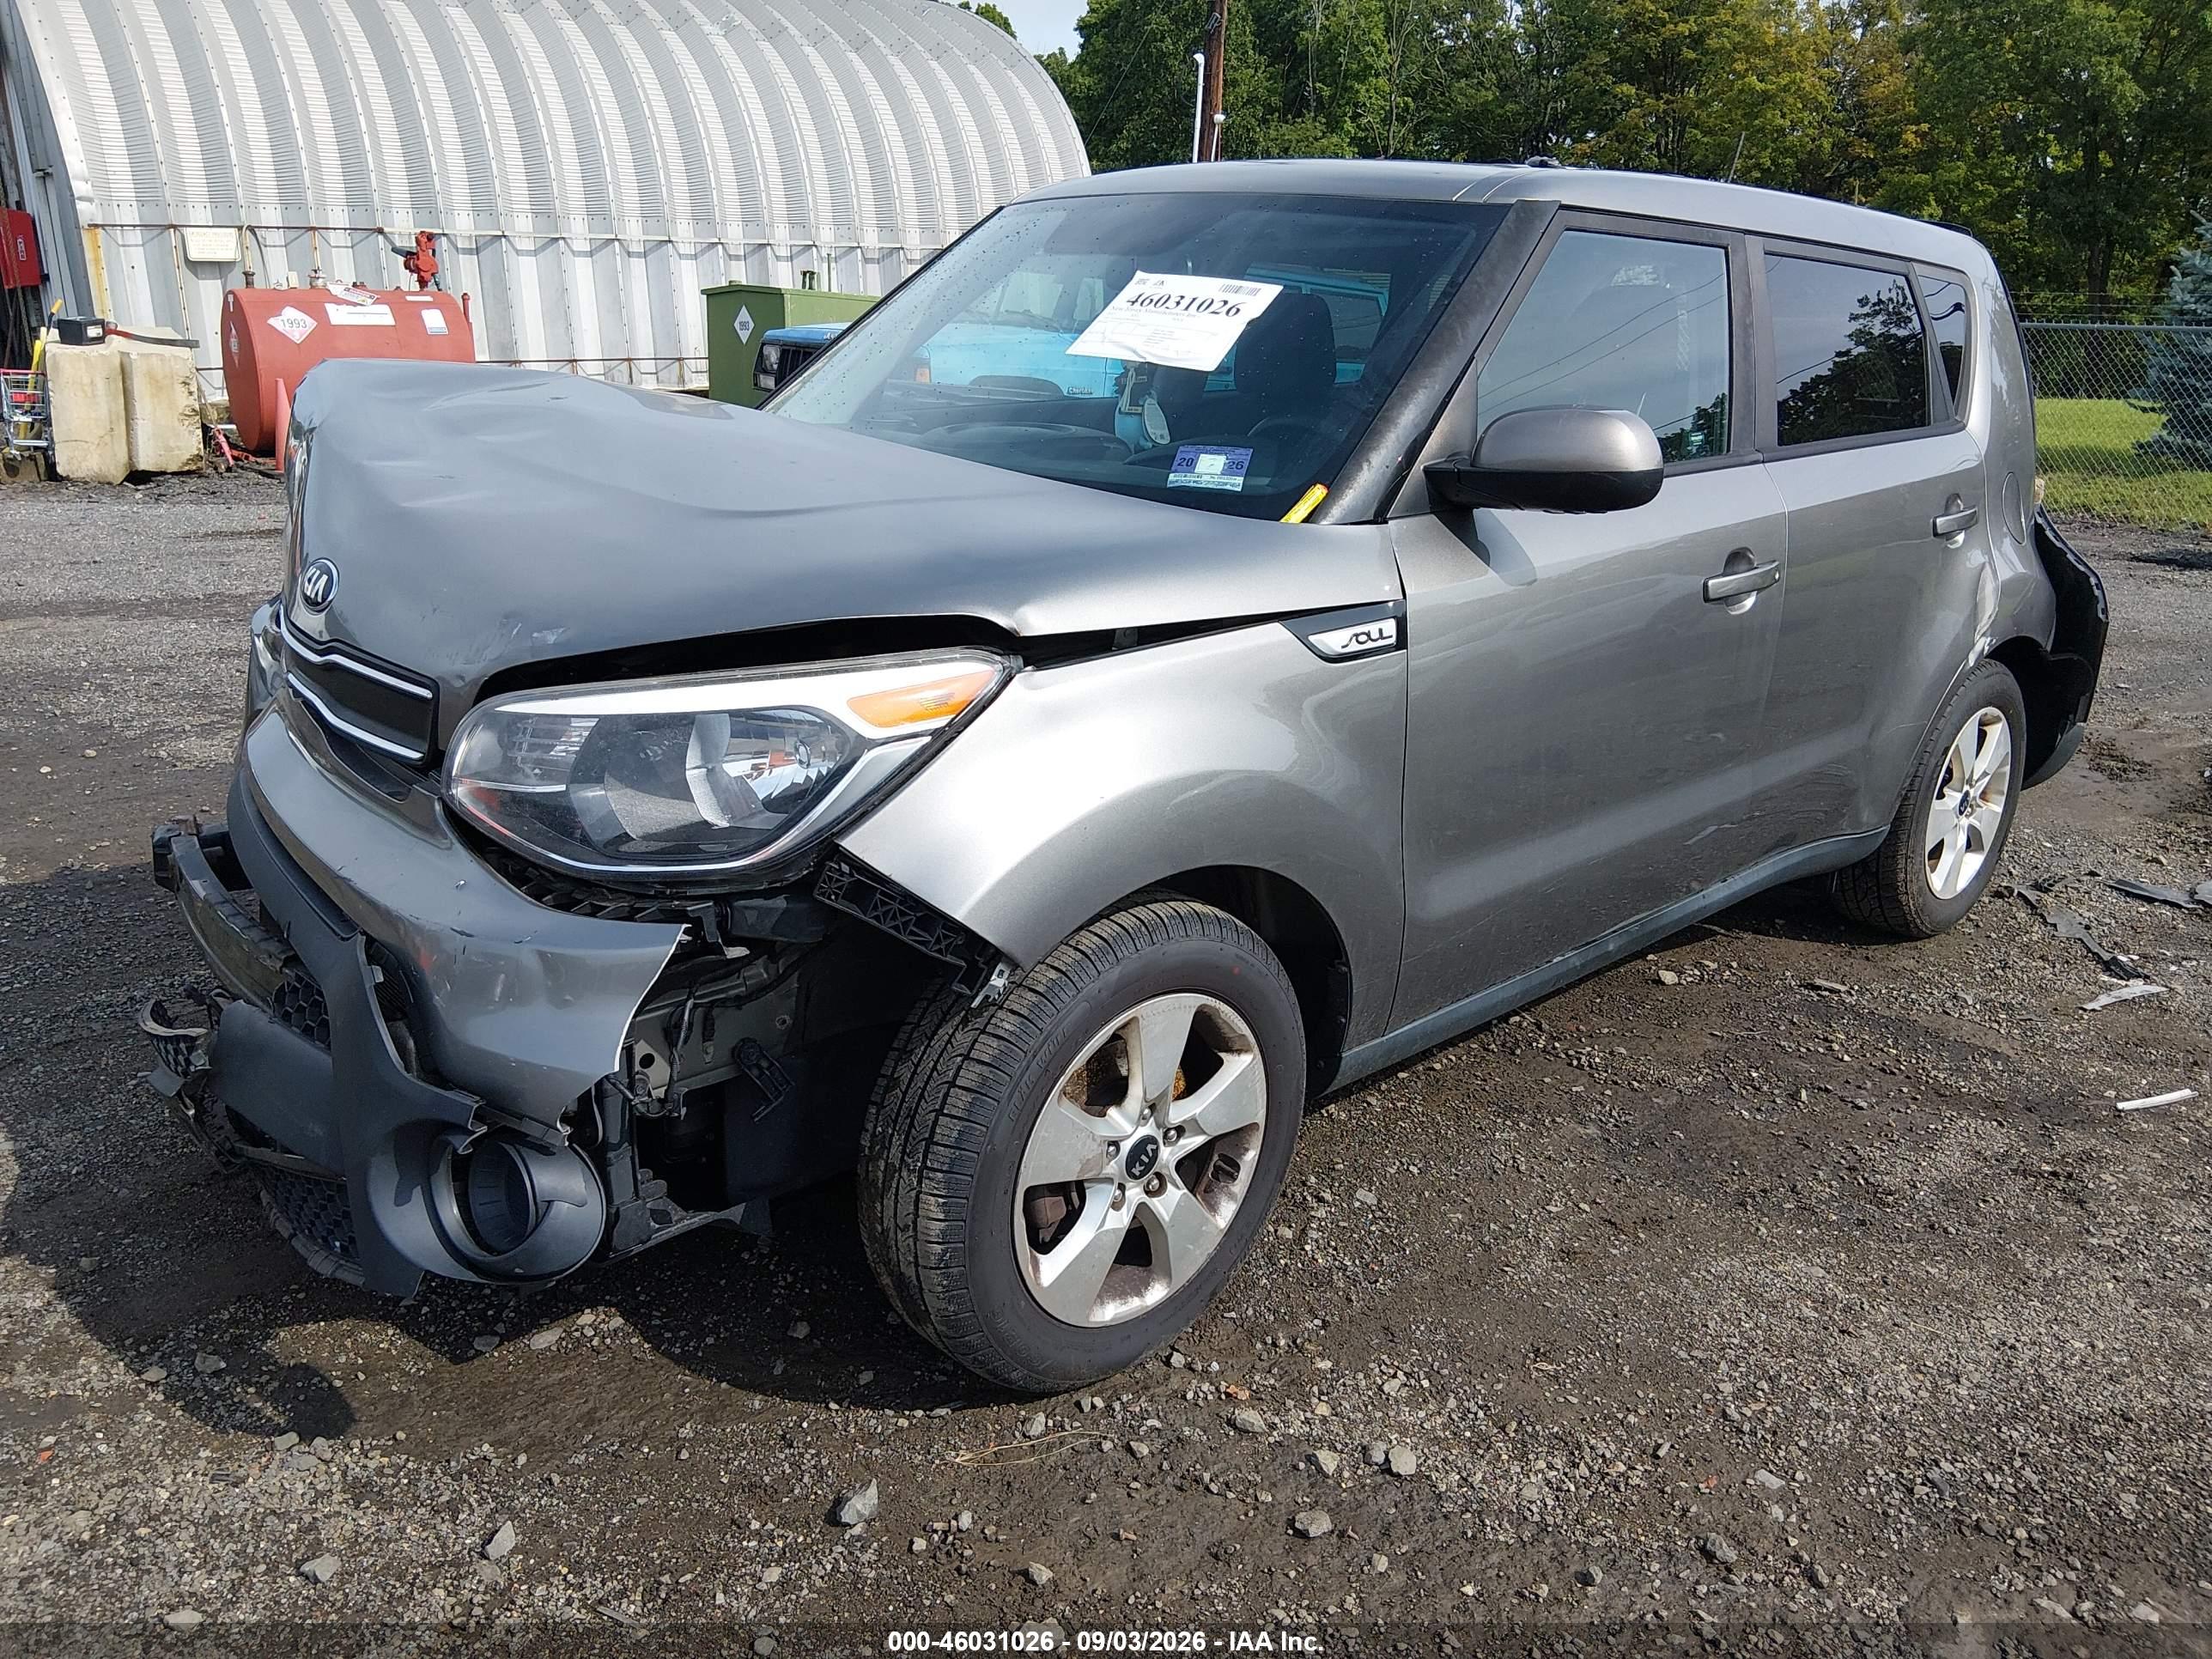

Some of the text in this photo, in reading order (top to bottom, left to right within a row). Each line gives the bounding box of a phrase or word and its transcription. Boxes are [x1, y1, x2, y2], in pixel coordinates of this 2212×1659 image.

[1126, 291, 1248, 318] 46031026
[280, 317, 308, 330] 1993
[738, 320, 750, 331] 1993
[1177, 457, 1194, 468] 20
[1227, 460, 1244, 471] 26
[304, 568, 329, 602] KIA
[1341, 628, 1394, 649] SOUL
[1131, 1143, 1158, 1176] KIA
